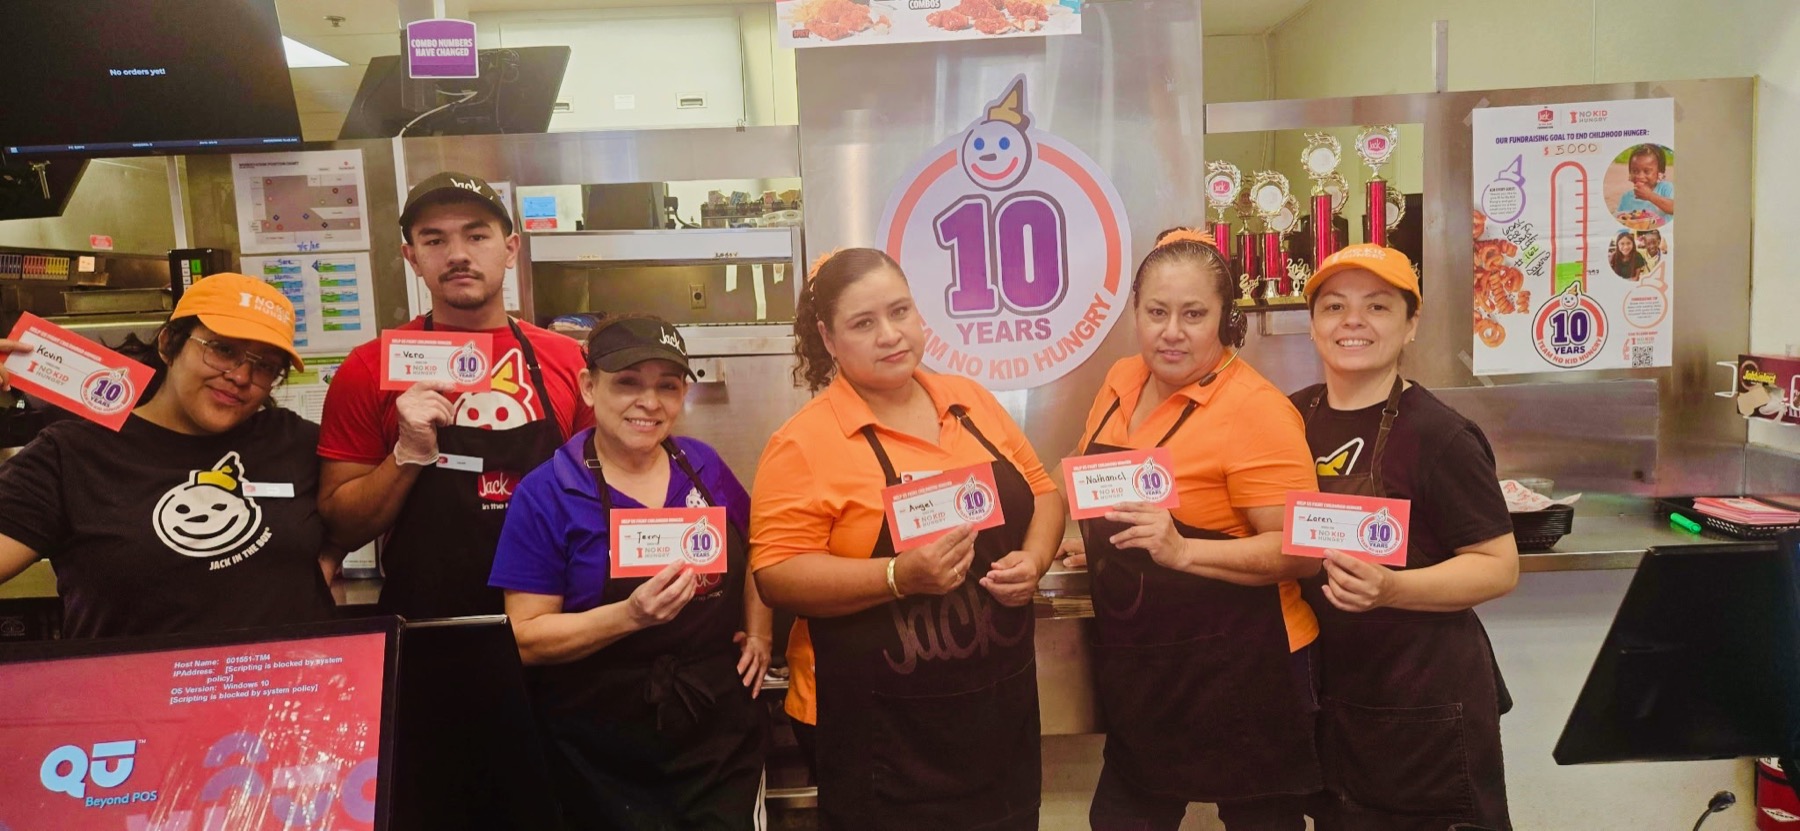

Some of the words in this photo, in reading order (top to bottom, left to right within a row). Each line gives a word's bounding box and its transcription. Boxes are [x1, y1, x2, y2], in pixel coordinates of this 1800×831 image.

[909, 0, 940, 9] COMBOS
[411, 39, 437, 48] COMBO
[439, 38, 473, 47] NUMBERS
[416, 48, 436, 56] HAVE
[436, 48, 470, 56] CHANGED
[123, 68, 149, 76] orders
[150, 68, 166, 77] yet!
[1509, 135, 1549, 144] FUNDRAISING
[1550, 134, 1565, 142] GOAL
[1576, 132, 1588, 140] END
[1589, 130, 1622, 139] CHILDHOOD
[1623, 129, 1650, 137] HUNGER:
[1544, 146, 1549, 155] $
[1555, 143, 1598, 156] 5000
[934, 190, 1069, 318] 10
[1525, 246, 1539, 259] 162
[255, 296, 274, 309] NO
[956, 318, 1052, 345] YEARS
[1549, 309, 1591, 346] 10
[947, 350, 984, 377] NO
[989, 357, 1028, 380] KID
[1033, 292, 1112, 372] HUNGRY
[37, 344, 63, 364] Kevin
[403, 351, 424, 359] Vero
[1538, 340, 1553, 359] TEAM
[1579, 338, 1602, 362] HUNGRY
[1554, 346, 1585, 354] YEARS
[458, 356, 477, 373] 10
[39, 364, 53, 375] NO
[52, 370, 69, 382] KID
[93, 380, 122, 401] 10
[480, 472, 512, 497] Jack
[1086, 472, 1127, 485] Nathaniel
[1142, 472, 1161, 490] 10
[909, 500, 934, 513] Angel
[963, 491, 984, 510] 10
[933, 511, 946, 519] KID
[1306, 514, 1333, 523] Loren
[637, 531, 660, 544] Terry
[1369, 523, 1391, 541] 10
[692, 533, 711, 551] 10
[209, 558, 231, 571] JACK
[232, 553, 243, 564] IN
[242, 544, 259, 558] THE
[194, 659, 219, 667] Name:
[225, 664, 263, 674] [Scripting
[273, 660, 302, 668] blocked
[305, 658, 313, 666] by
[316, 657, 343, 665] system
[206, 674, 234, 684] policy]
[170, 694, 208, 705] [Scripting
[219, 690, 249, 699] blocked
[251, 689, 261, 698] by
[262, 687, 290, 696] system
[292, 684, 318, 694] policy]
[171, 687, 183, 695] OS
[185, 685, 217, 694] Version:
[223, 682, 258, 690] Windows
[85, 793, 129, 808] Beyond
[132, 791, 157, 803] POS
